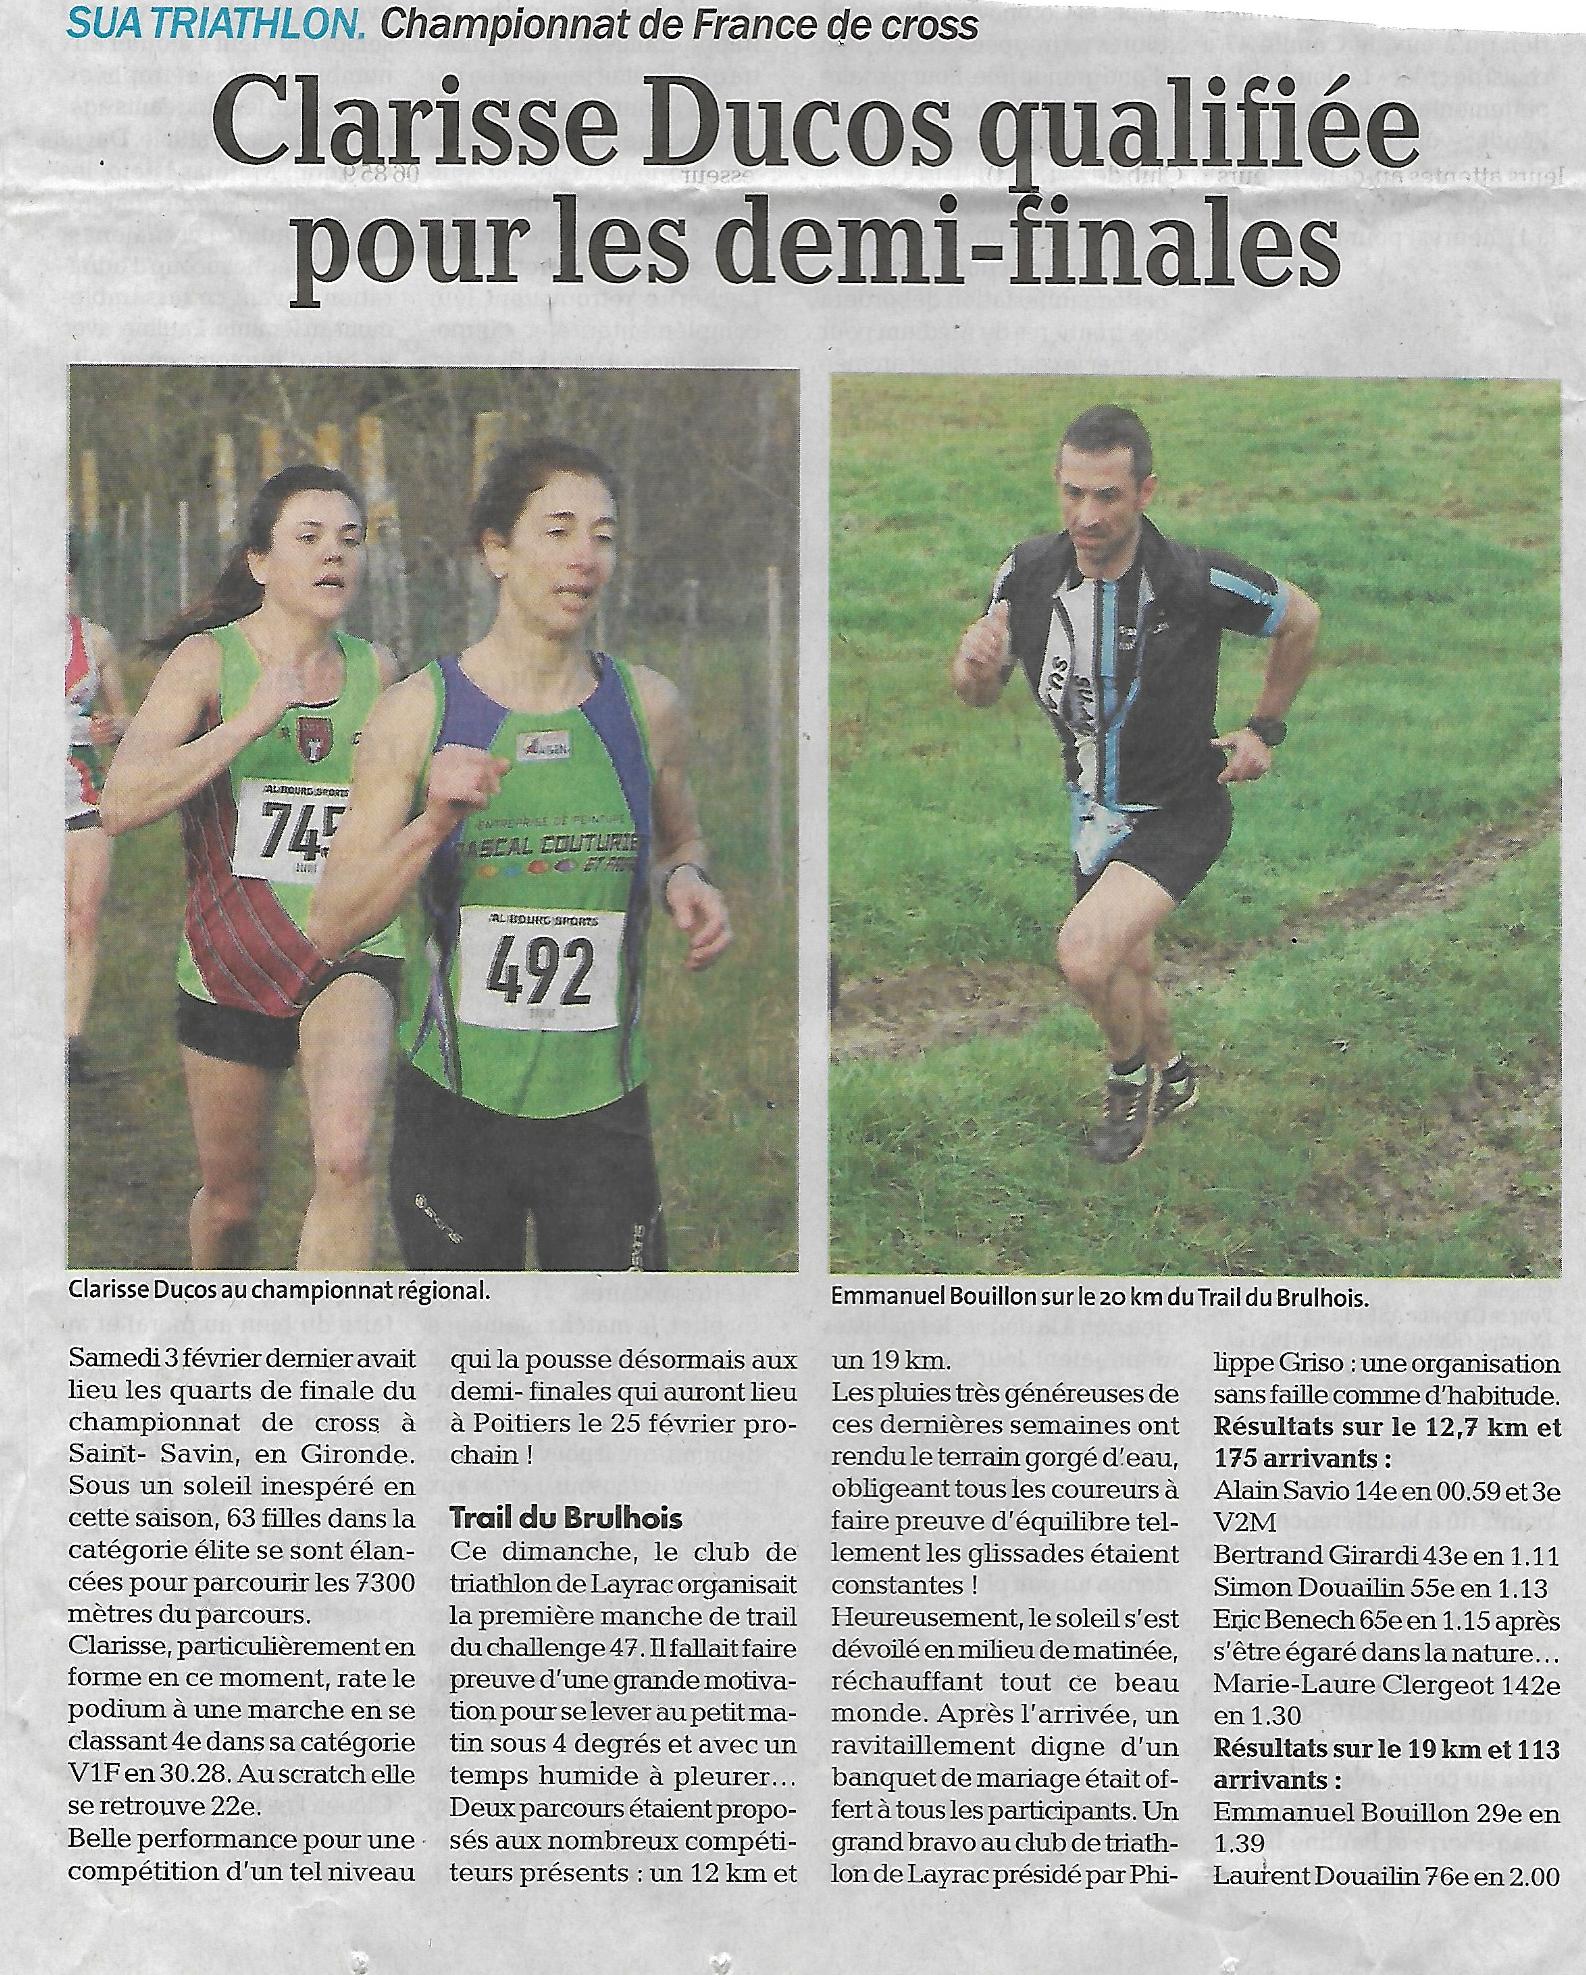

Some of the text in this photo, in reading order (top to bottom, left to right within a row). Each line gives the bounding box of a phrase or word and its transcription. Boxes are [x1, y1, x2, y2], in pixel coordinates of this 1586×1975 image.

[66, 5, 980, 47] SUA TRIATHLON. Championnat de France de cross
[212, 72, 1420, 194] Clarisse Ducos qualifiée
[289, 193, 1341, 309] pour les demi-finales
[486, 935, 594, 1005] 492
[67, 1277, 491, 1306] Clarisse Ducos au championnat régional.
[832, 1284, 1370, 1308] Emmanuel Bouillon sur le 20 km du Trail du Brulhois.
[69, 1346, 417, 1369] Samedi 3 février dernier avait
[450, 1348, 798, 1375] qui la pousse désormais aux
[831, 1349, 951, 1370] un 19 km.
[450, 1411, 797, 1440] à Poitiers le 25 février pro-
[832, 1413, 1181, 1436] ces dernières semaines ont
[1213, 1415, 1563, 1440] Résultats sur le 12,7 km et
[69, 1442, 415, 1467] Saint- Savin, en Gironde.
[1215, 1447, 1391, 1469] 175 arrivants :
[832, 1477, 1180, 1504] obligeant tous les coureurs à
[1213, 1479, 1561, 1502] Alain Savio 14e en 00.59 et 3e
[68, 1507, 417, 1531] cette saison, 63 filles dans la
[448, 1503, 683, 1530] Trail du Brulhois
[1212, 1511, 1277, 1533] V2M
[1213, 1543, 1559, 1567] Bertrand Girardi 43e en 1.11
[449, 1604, 798, 1631] la première manche de trail
[68, 1634, 416, 1661] Clarisse, particulièrement en
[1213, 1736, 1560, 1760] Résultats sur le 19 km et 113
[831, 1766, 1179, 1794] banquet de mariage était of-
[1213, 1769, 1342, 1790] arrivants :
[1213, 1801, 1561, 1824] Emmanuel Bouillon 29e en
[67, 1827, 415, 1855] Belle performance pour une
[1215, 1833, 1265, 1854] 1.39
[1213, 1865, 1560, 1887] Laurent Douailin 76e en 2.00
